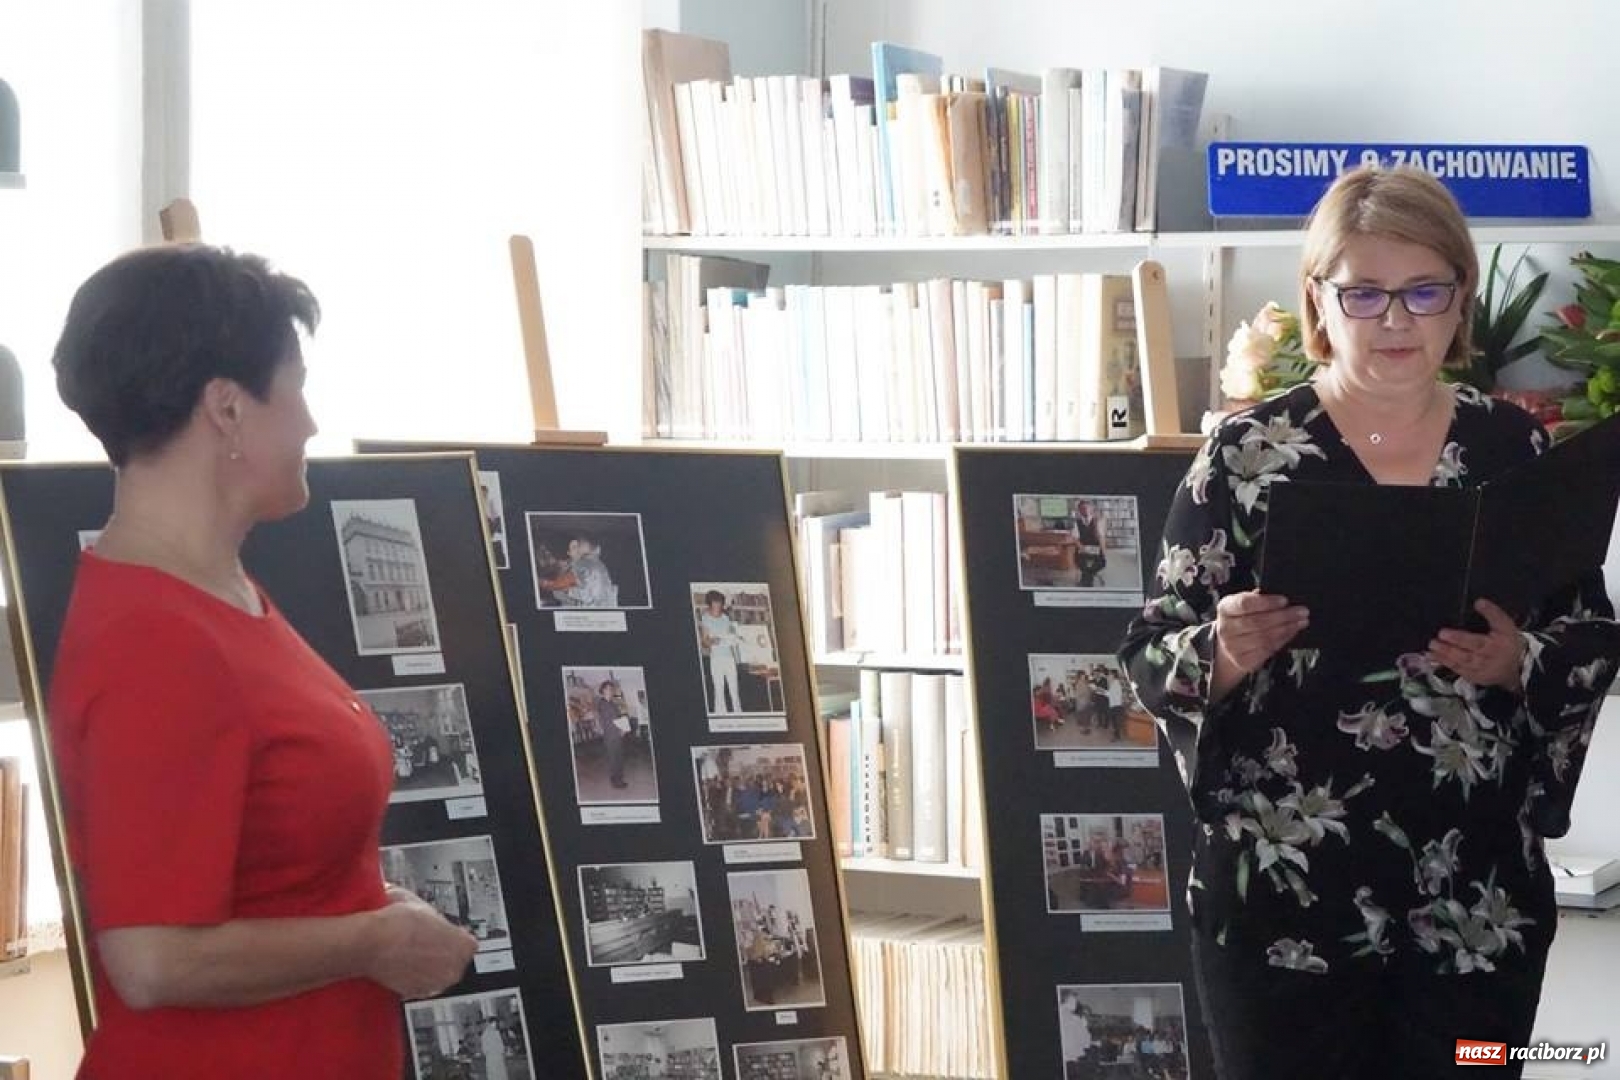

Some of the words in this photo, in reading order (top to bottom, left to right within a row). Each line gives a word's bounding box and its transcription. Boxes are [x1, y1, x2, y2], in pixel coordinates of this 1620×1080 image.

[1217, 148, 1349, 177] PROSIMY
[1391, 149, 1577, 179] ZACHOWANIE
[1111, 408, 1127, 428] R
